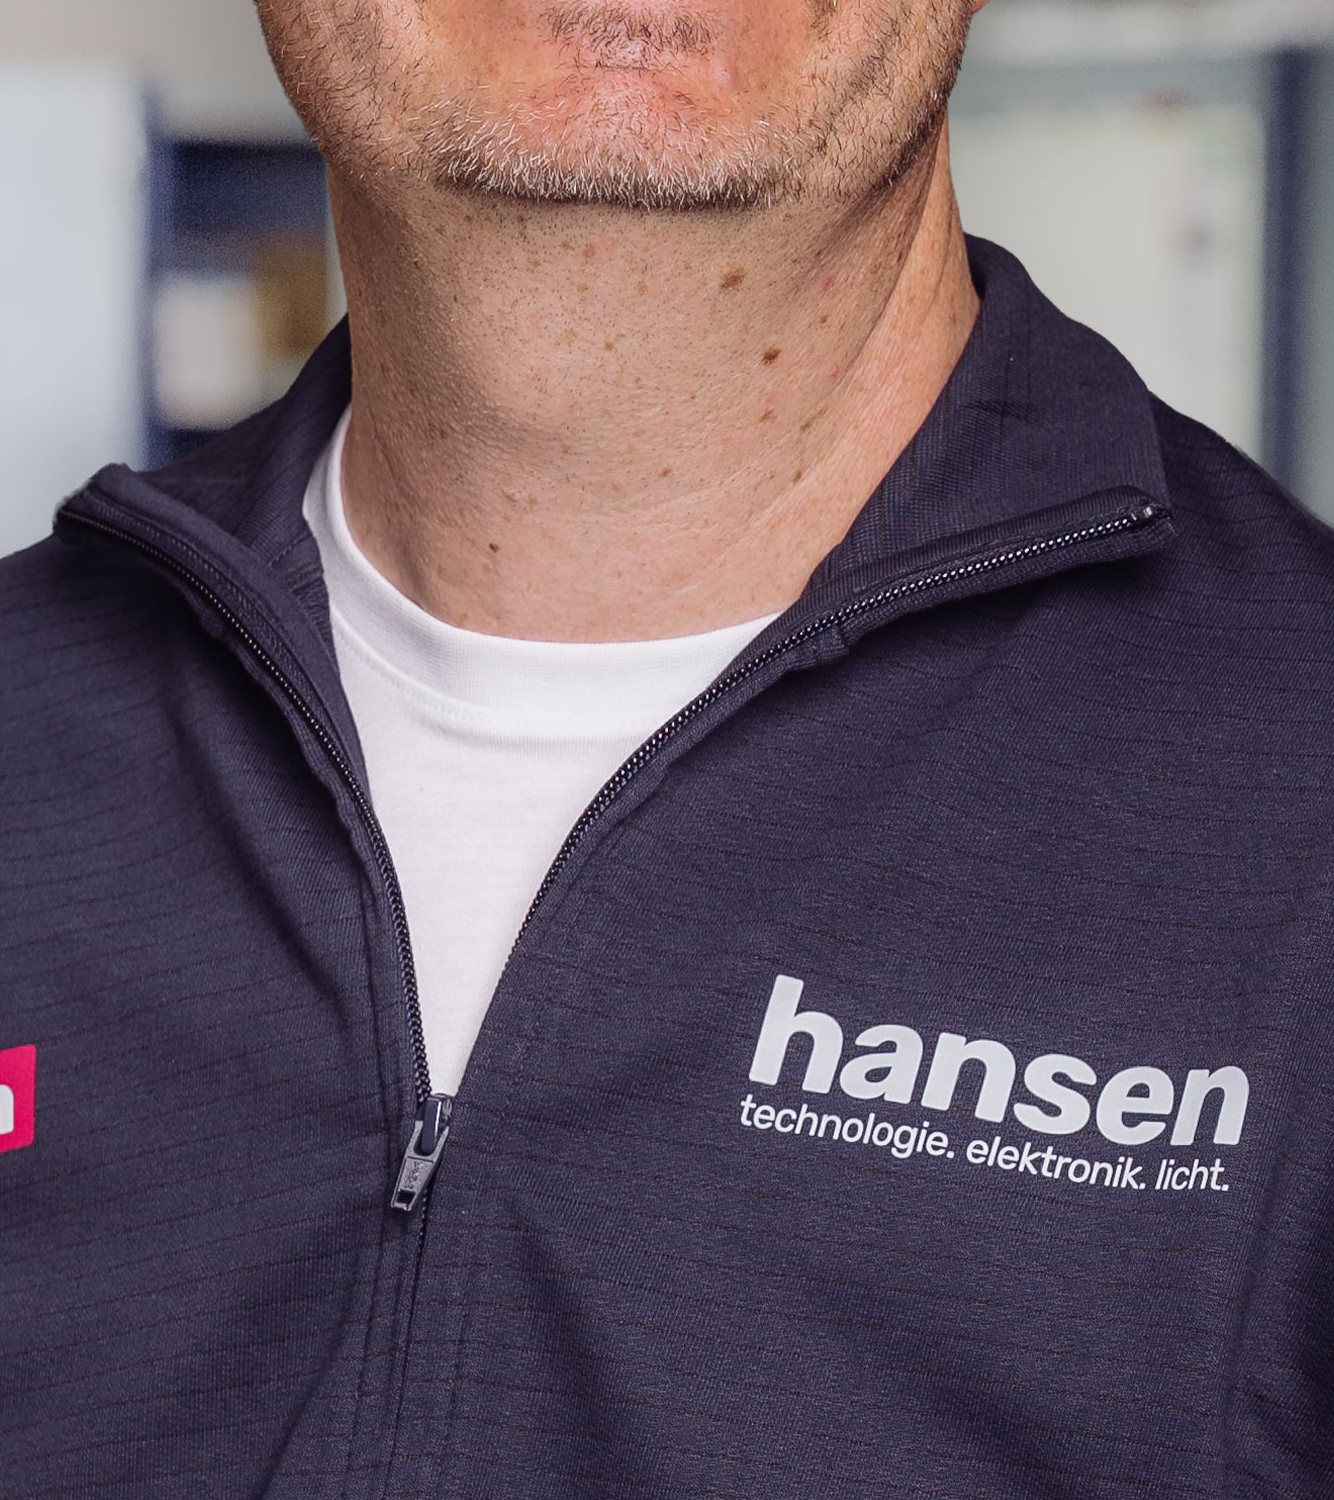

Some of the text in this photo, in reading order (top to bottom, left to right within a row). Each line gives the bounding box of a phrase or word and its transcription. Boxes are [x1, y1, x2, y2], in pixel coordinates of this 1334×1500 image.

[748, 974, 1250, 1146] hansen
[740, 1093, 1230, 1192] technologie. elektronik. licht.
